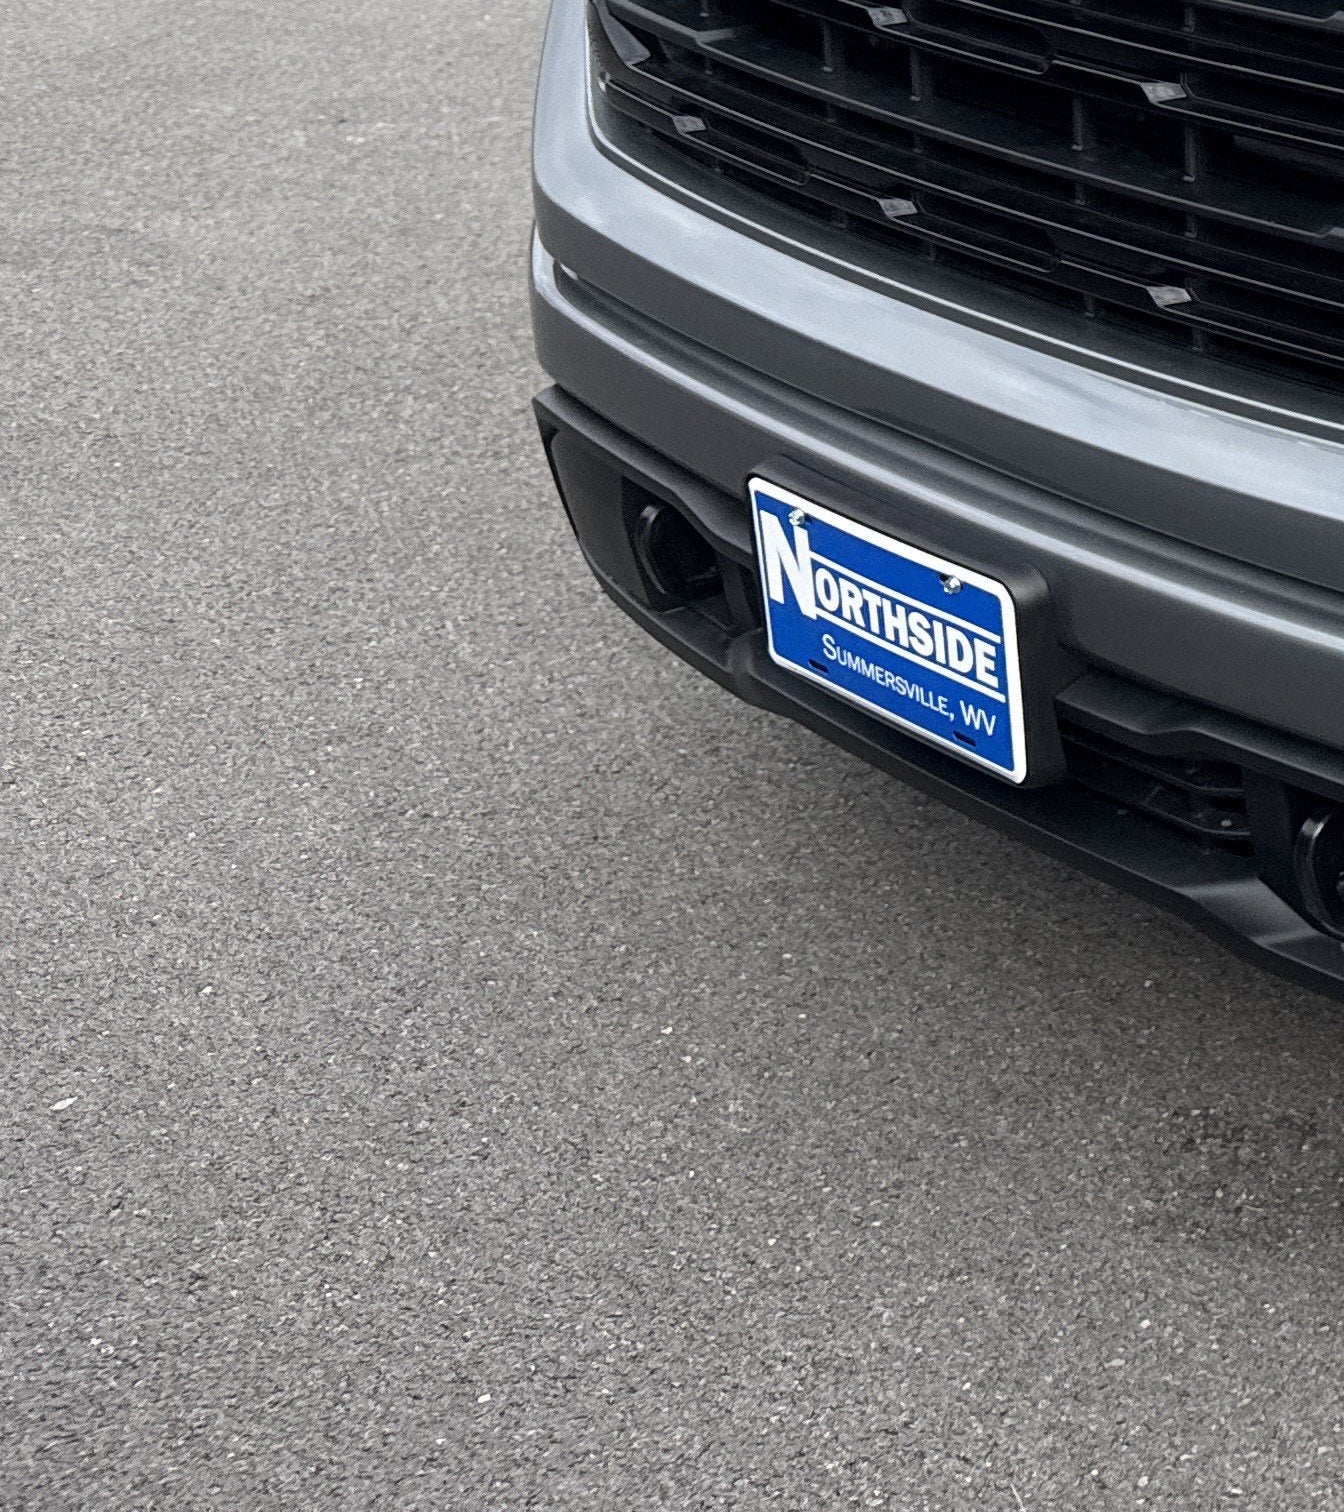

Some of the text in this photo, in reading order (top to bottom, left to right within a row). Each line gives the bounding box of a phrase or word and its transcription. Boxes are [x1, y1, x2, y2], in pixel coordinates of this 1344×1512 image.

[759, 509, 1000, 690] NORTHSIDE
[821, 633, 998, 737] SUMMERSVILLE, WV
